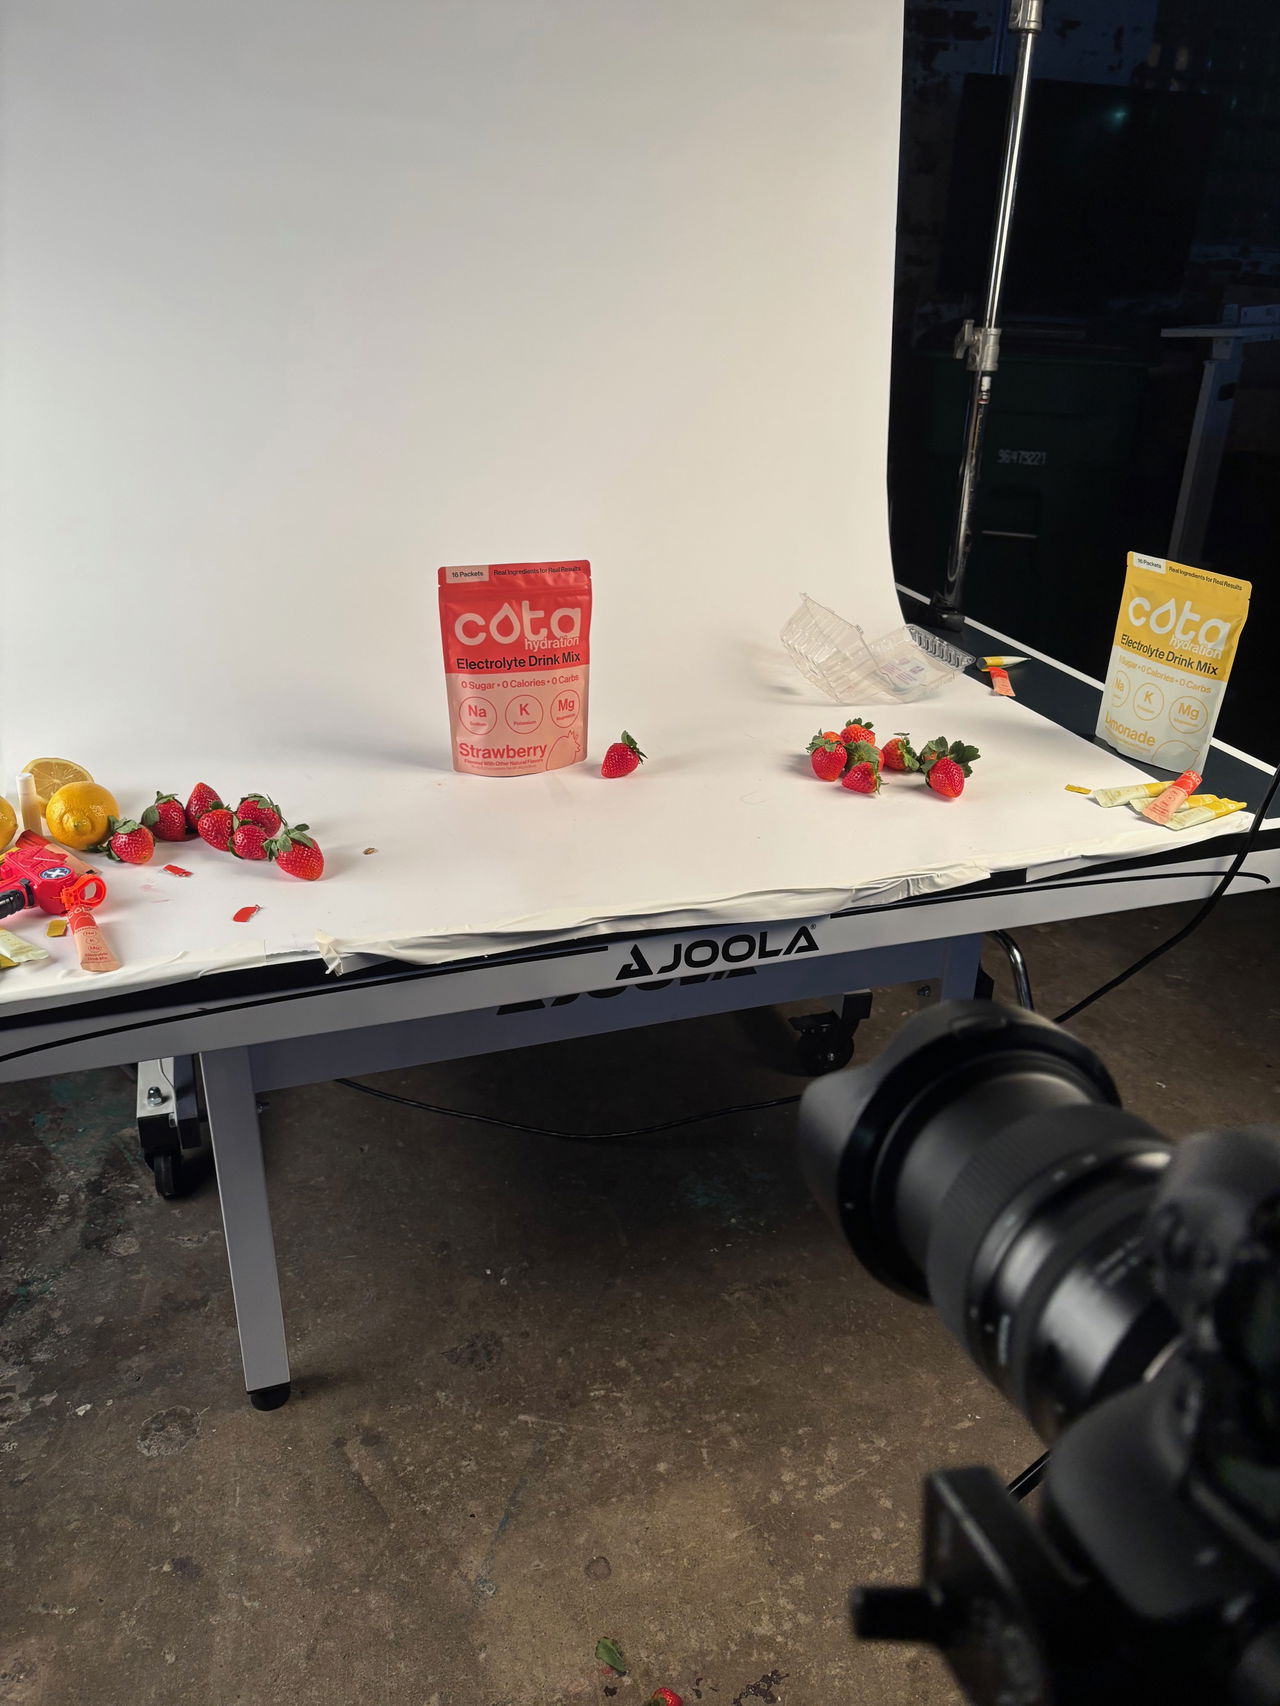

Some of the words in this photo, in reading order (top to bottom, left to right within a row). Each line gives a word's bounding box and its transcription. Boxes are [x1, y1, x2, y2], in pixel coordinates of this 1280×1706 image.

[1143, 559, 1161, 568] Packets
[508, 568, 539, 576] Ingredients
[1179, 569, 1205, 581] Ingredients
[1213, 578, 1223, 586] Real
[1224, 581, 1242, 591] Results
[525, 636, 578, 651] hydration
[1169, 634, 1222, 659] hydration
[457, 658, 526, 670] Electrolyte
[529, 655, 560, 667] Drink
[562, 652, 580, 663] Mix
[1121, 634, 1165, 660] Electrolyte
[1166, 651, 1194, 669] Drink
[1196, 661, 1219, 675] Mix
[469, 681, 495, 691] Sugar
[510, 679, 545, 688] Calories
[559, 674, 579, 683] Carbs
[1186, 680, 1212, 694] Carbs
[558, 699, 575, 711] Mg
[1144, 691, 1154, 704] K
[468, 704, 487, 717] Na
[520, 704, 530, 716] K
[1178, 703, 1199, 720] Mg
[459, 742, 547, 759] Strawberry
